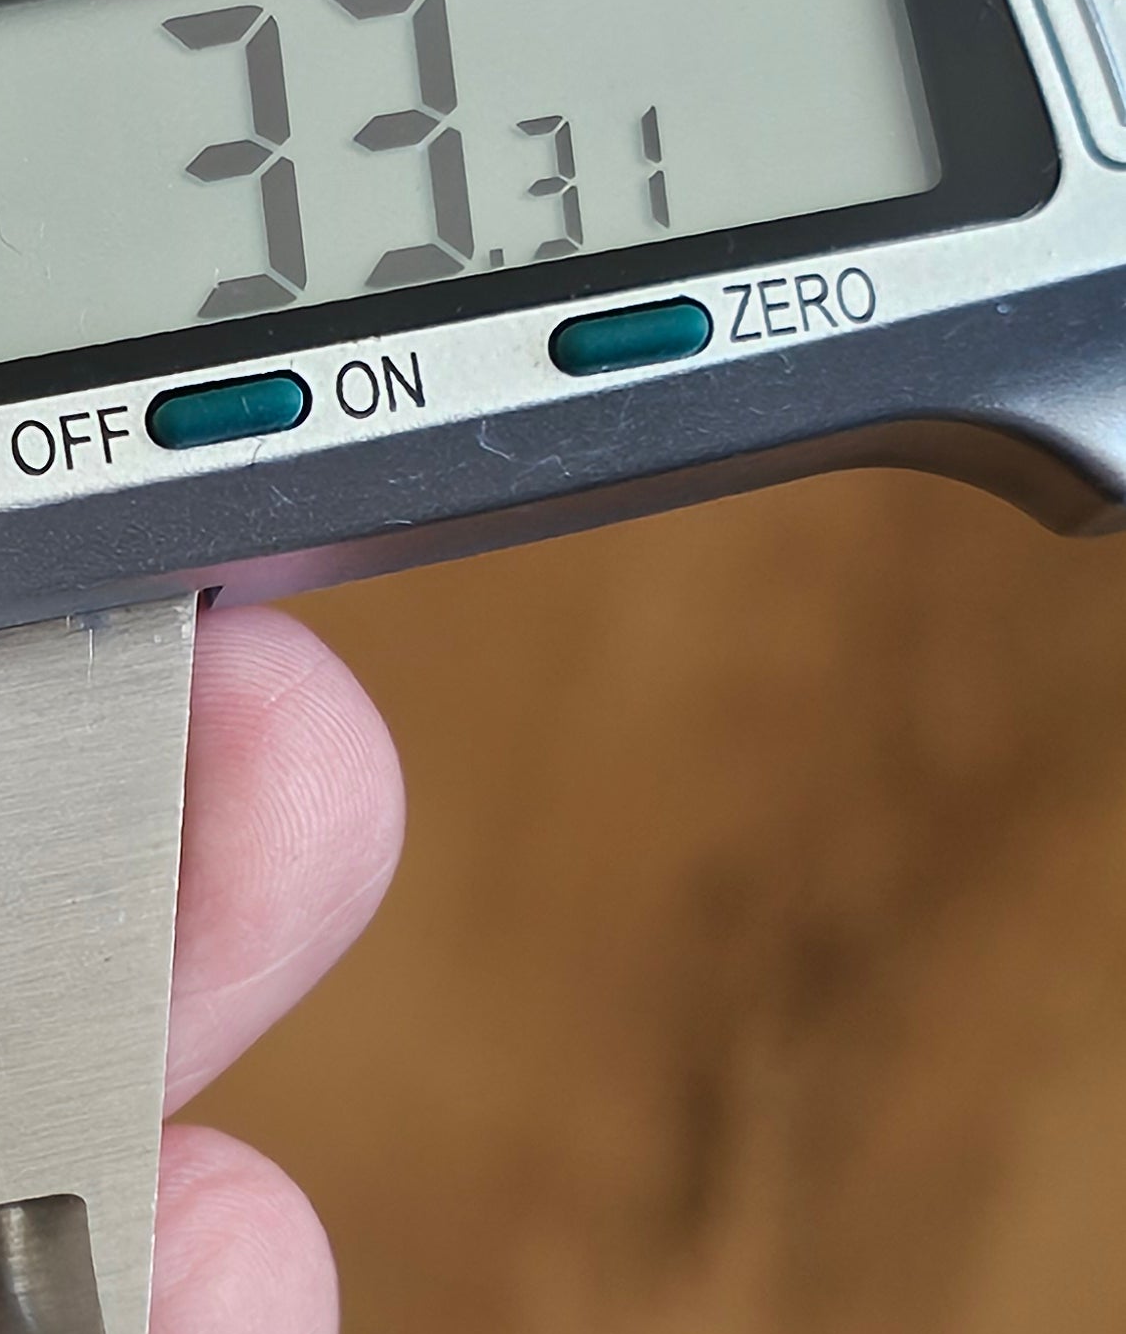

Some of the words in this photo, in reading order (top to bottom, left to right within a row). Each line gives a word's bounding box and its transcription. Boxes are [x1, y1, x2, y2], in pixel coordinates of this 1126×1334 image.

[721, 266, 878, 344] ZERO
[9, 404, 131, 477] OFF
[334, 350, 427, 420] ON
